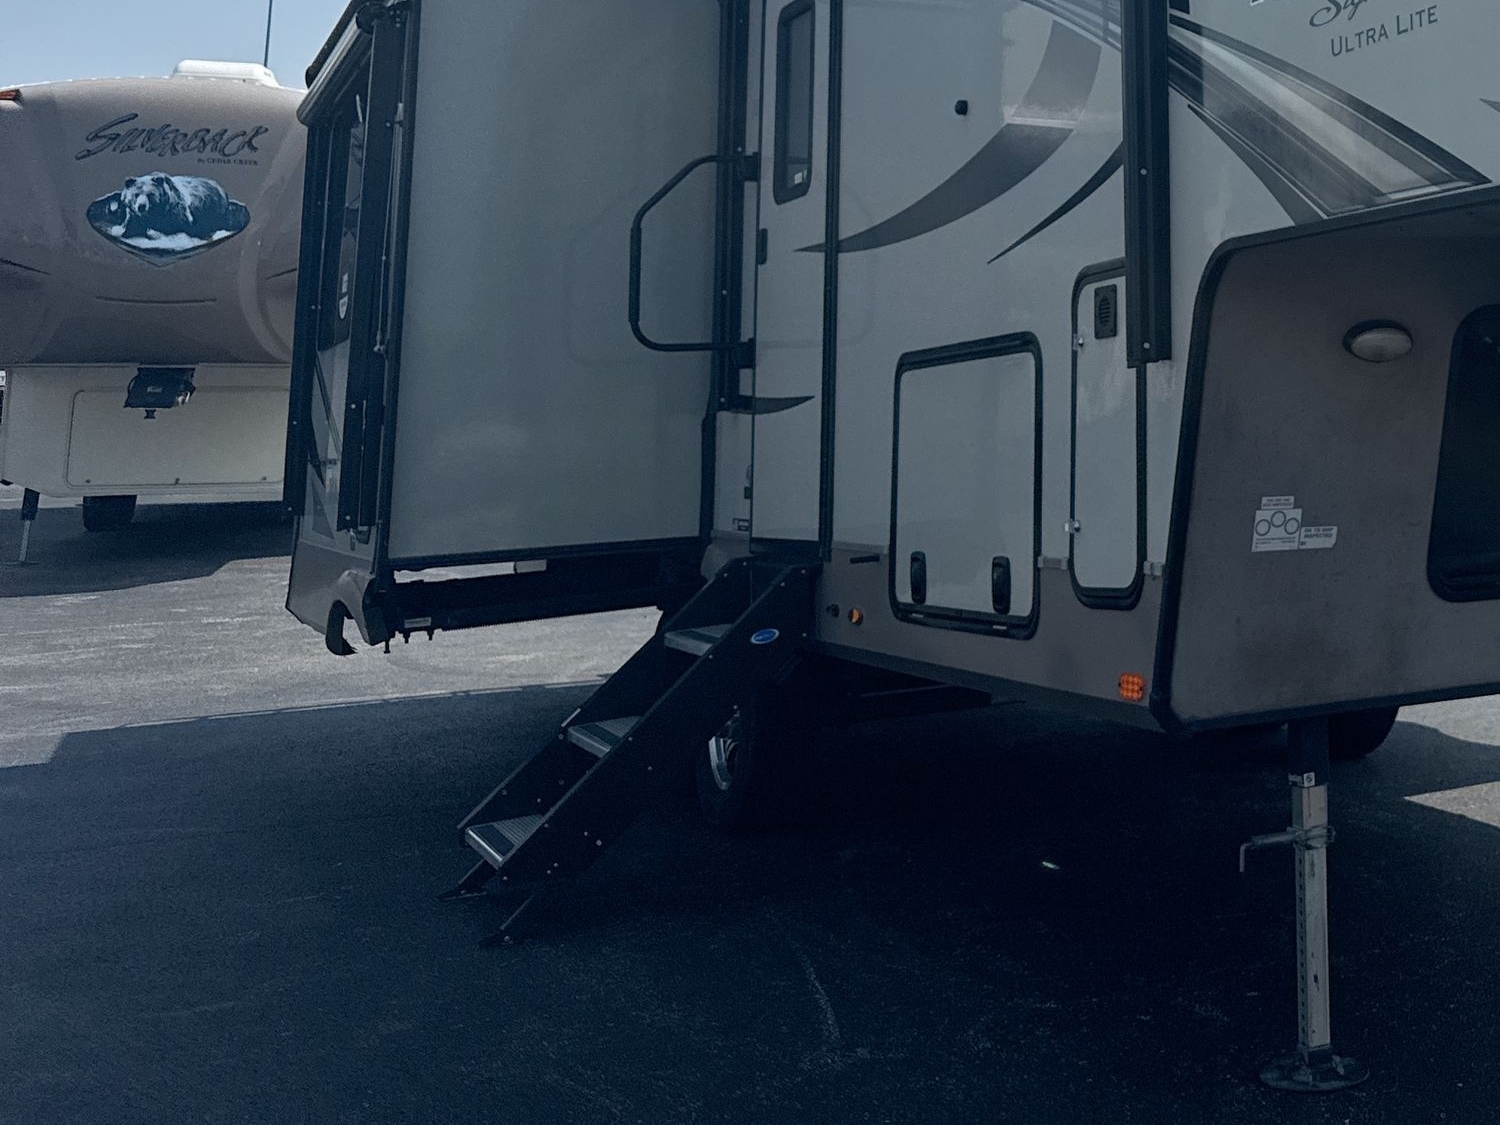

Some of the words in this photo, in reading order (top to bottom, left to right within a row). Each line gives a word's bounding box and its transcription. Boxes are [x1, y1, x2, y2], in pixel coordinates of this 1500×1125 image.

[1330, 23, 1389, 57] ULTRA
[1396, 5, 1439, 35] LITE
[75, 113, 269, 160] SILVERBACK
